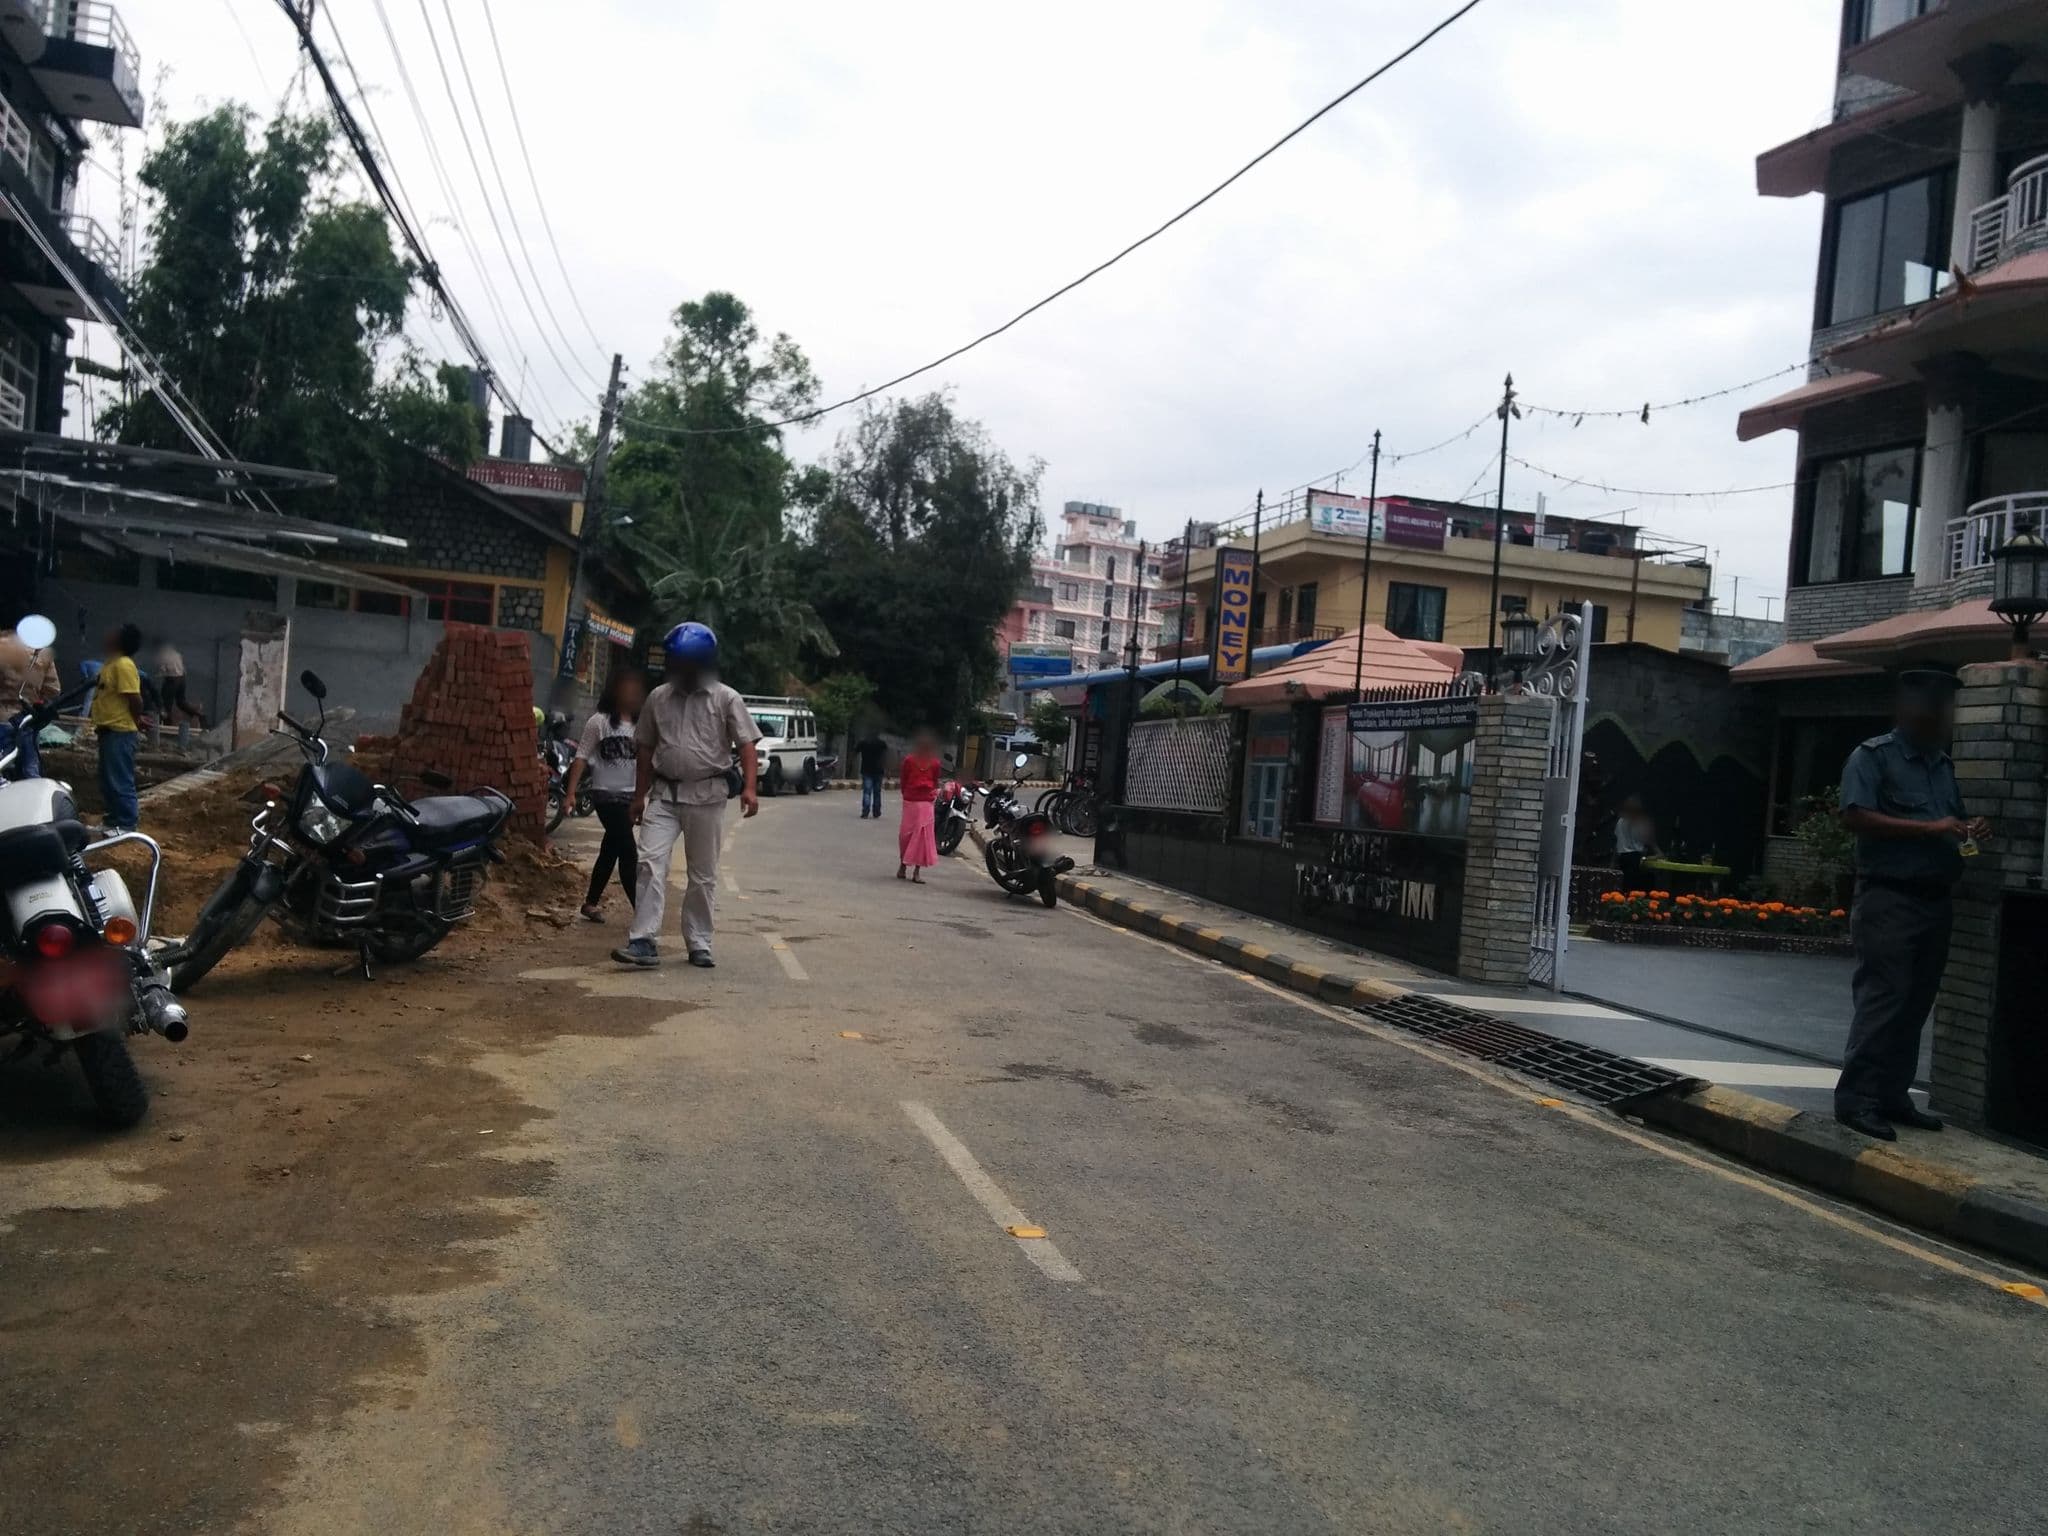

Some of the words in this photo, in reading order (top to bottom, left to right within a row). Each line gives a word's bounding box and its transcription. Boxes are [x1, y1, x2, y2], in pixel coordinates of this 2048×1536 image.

[1336, 508, 1345, 520] 2
[609, 628, 632, 642] HOUSE
[1221, 568, 1250, 667] MONEY
[564, 628, 578, 670] TARA
[1401, 879, 1436, 921] INN
